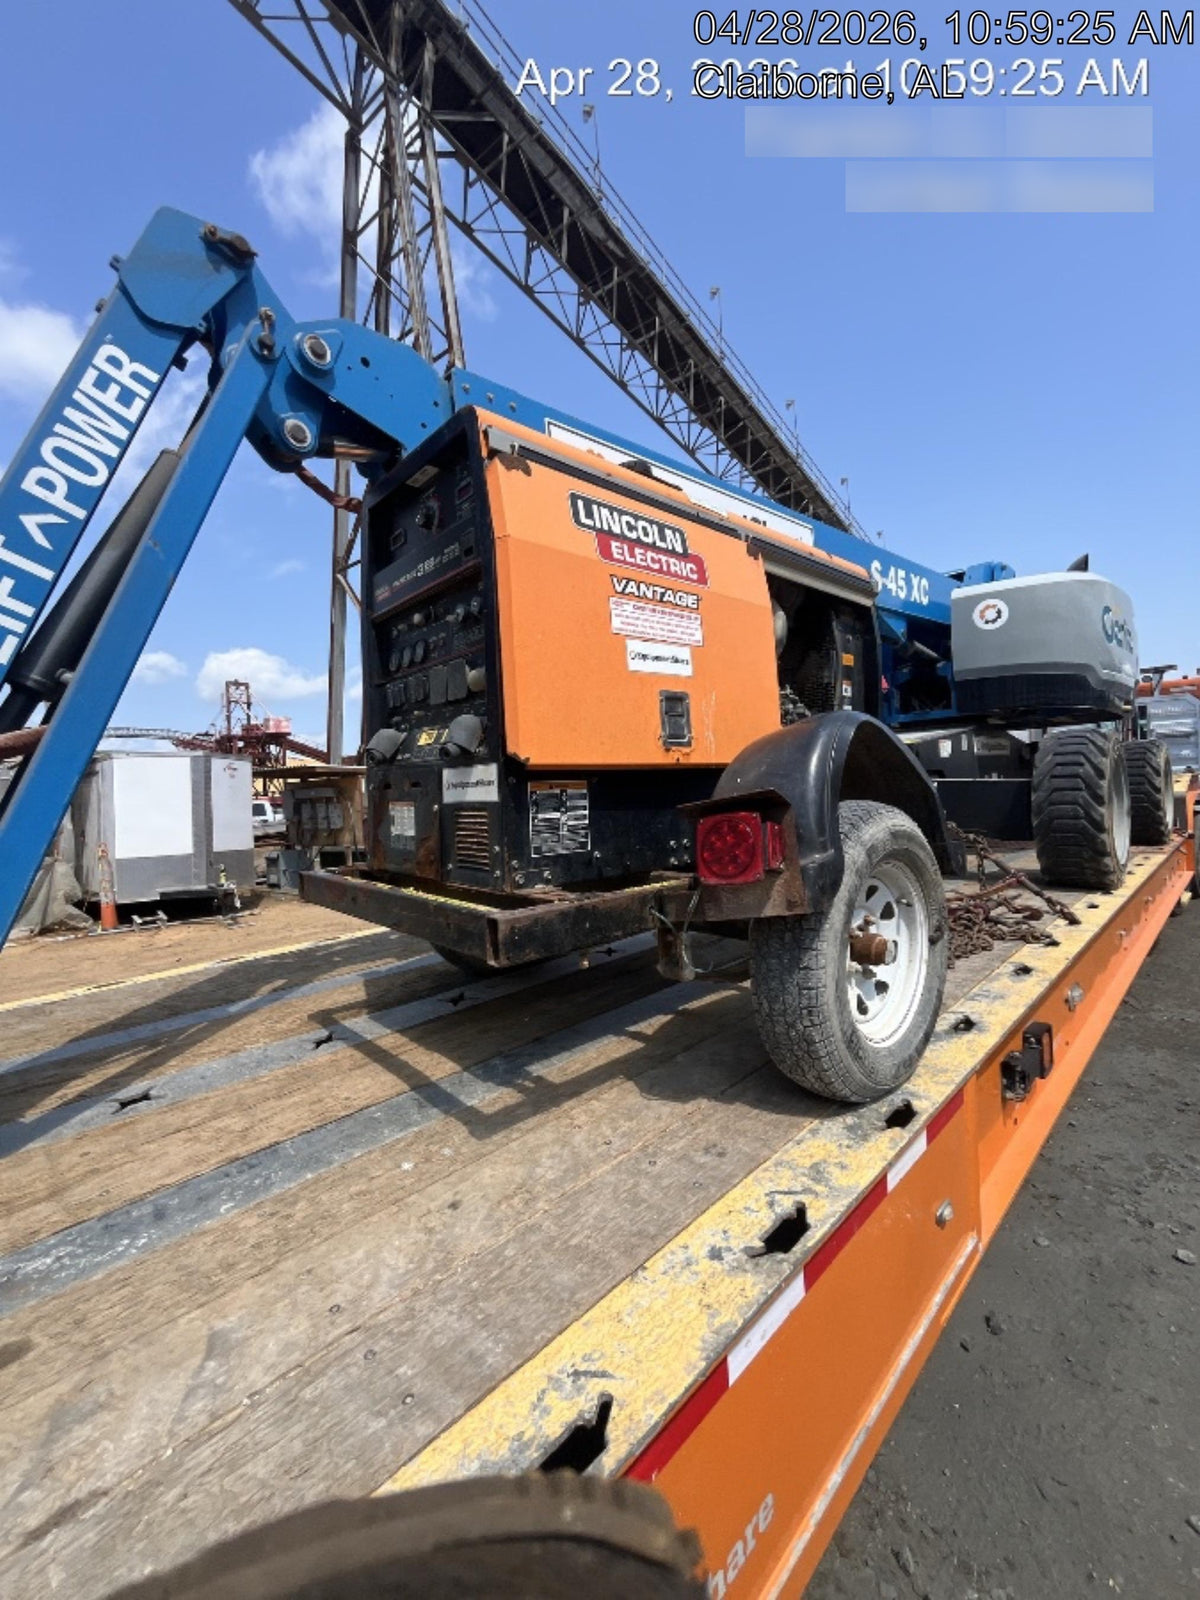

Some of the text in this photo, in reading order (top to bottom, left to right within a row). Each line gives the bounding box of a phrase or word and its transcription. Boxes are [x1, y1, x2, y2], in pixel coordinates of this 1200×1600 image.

[20, 343, 161, 521] POWER
[576, 497, 685, 554] LINCOLN
[609, 539, 699, 581] ELECTRIC
[871, 559, 929, 606] S-45 XC
[609, 574, 700, 610] VANTAGE
